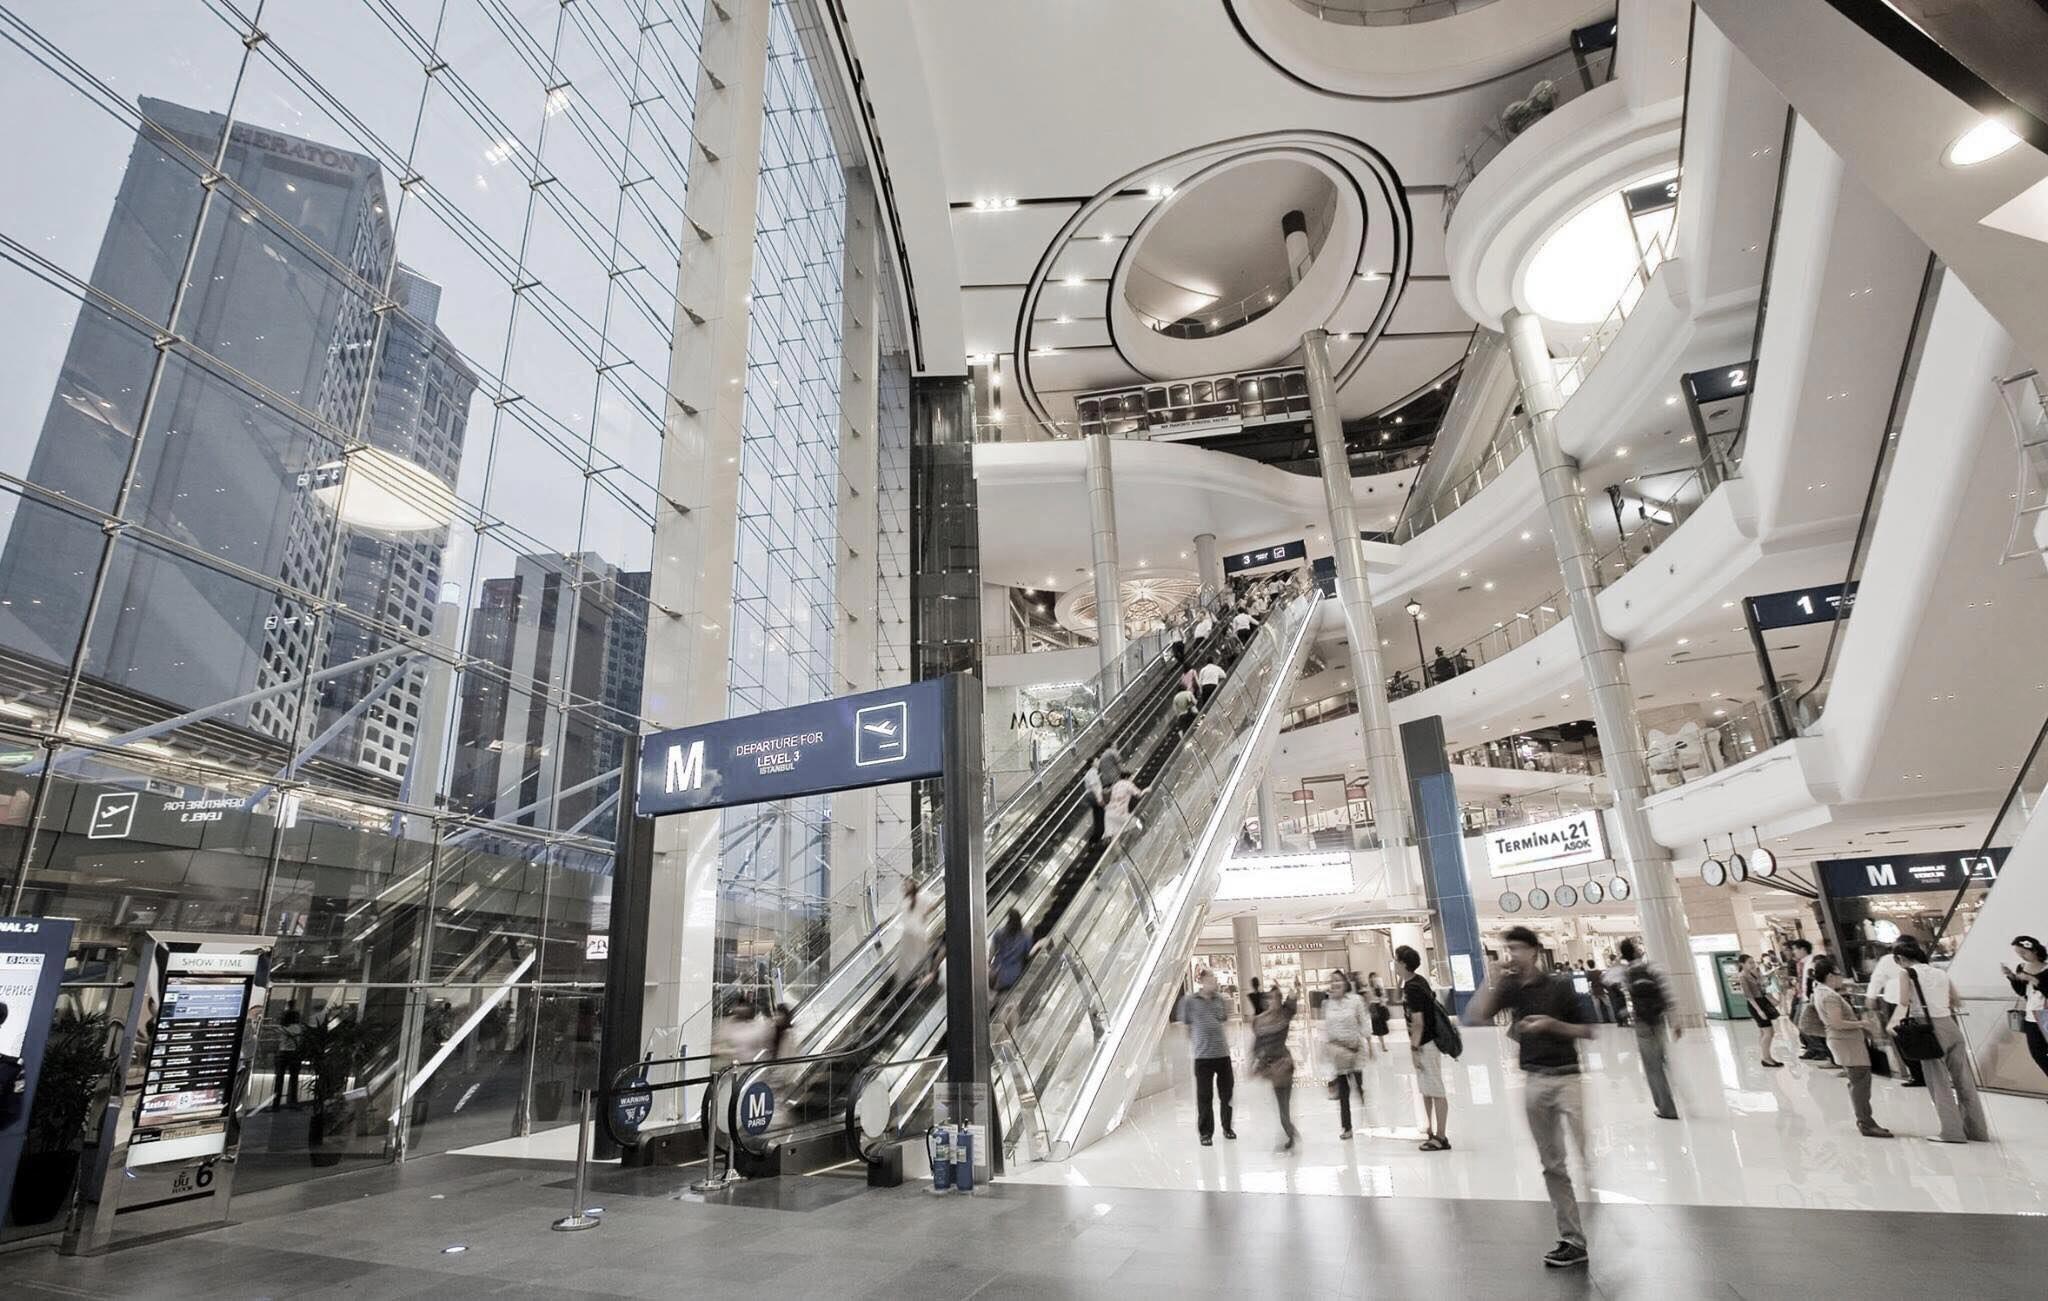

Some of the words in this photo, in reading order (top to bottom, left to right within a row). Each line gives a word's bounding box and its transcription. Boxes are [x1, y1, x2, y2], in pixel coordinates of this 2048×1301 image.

[1728, 369, 1748, 388] 2
[1224, 404, 1237, 414] 21
[1243, 555, 1251, 565] 3
[1796, 595, 1814, 615] 1
[736, 735, 798, 756] DEPARTURE
[800, 731, 824, 746] FOR
[665, 740, 704, 794] M
[757, 754, 791, 768] LEVEL
[793, 751, 800, 762] 3
[759, 763, 795, 775] ISTANBUL
[1564, 839, 1591, 852] ASOK
[1866, 864, 1897, 887] M
[24, 923, 39, 933] 21
[182, 958, 213, 967] SHOW
[219, 959, 243, 968] TIME
[620, 1094, 650, 1105] WARNING
[749, 1092, 765, 1118] M
[748, 1118, 766, 1128] PARIS
[196, 1162, 213, 1188] 6
